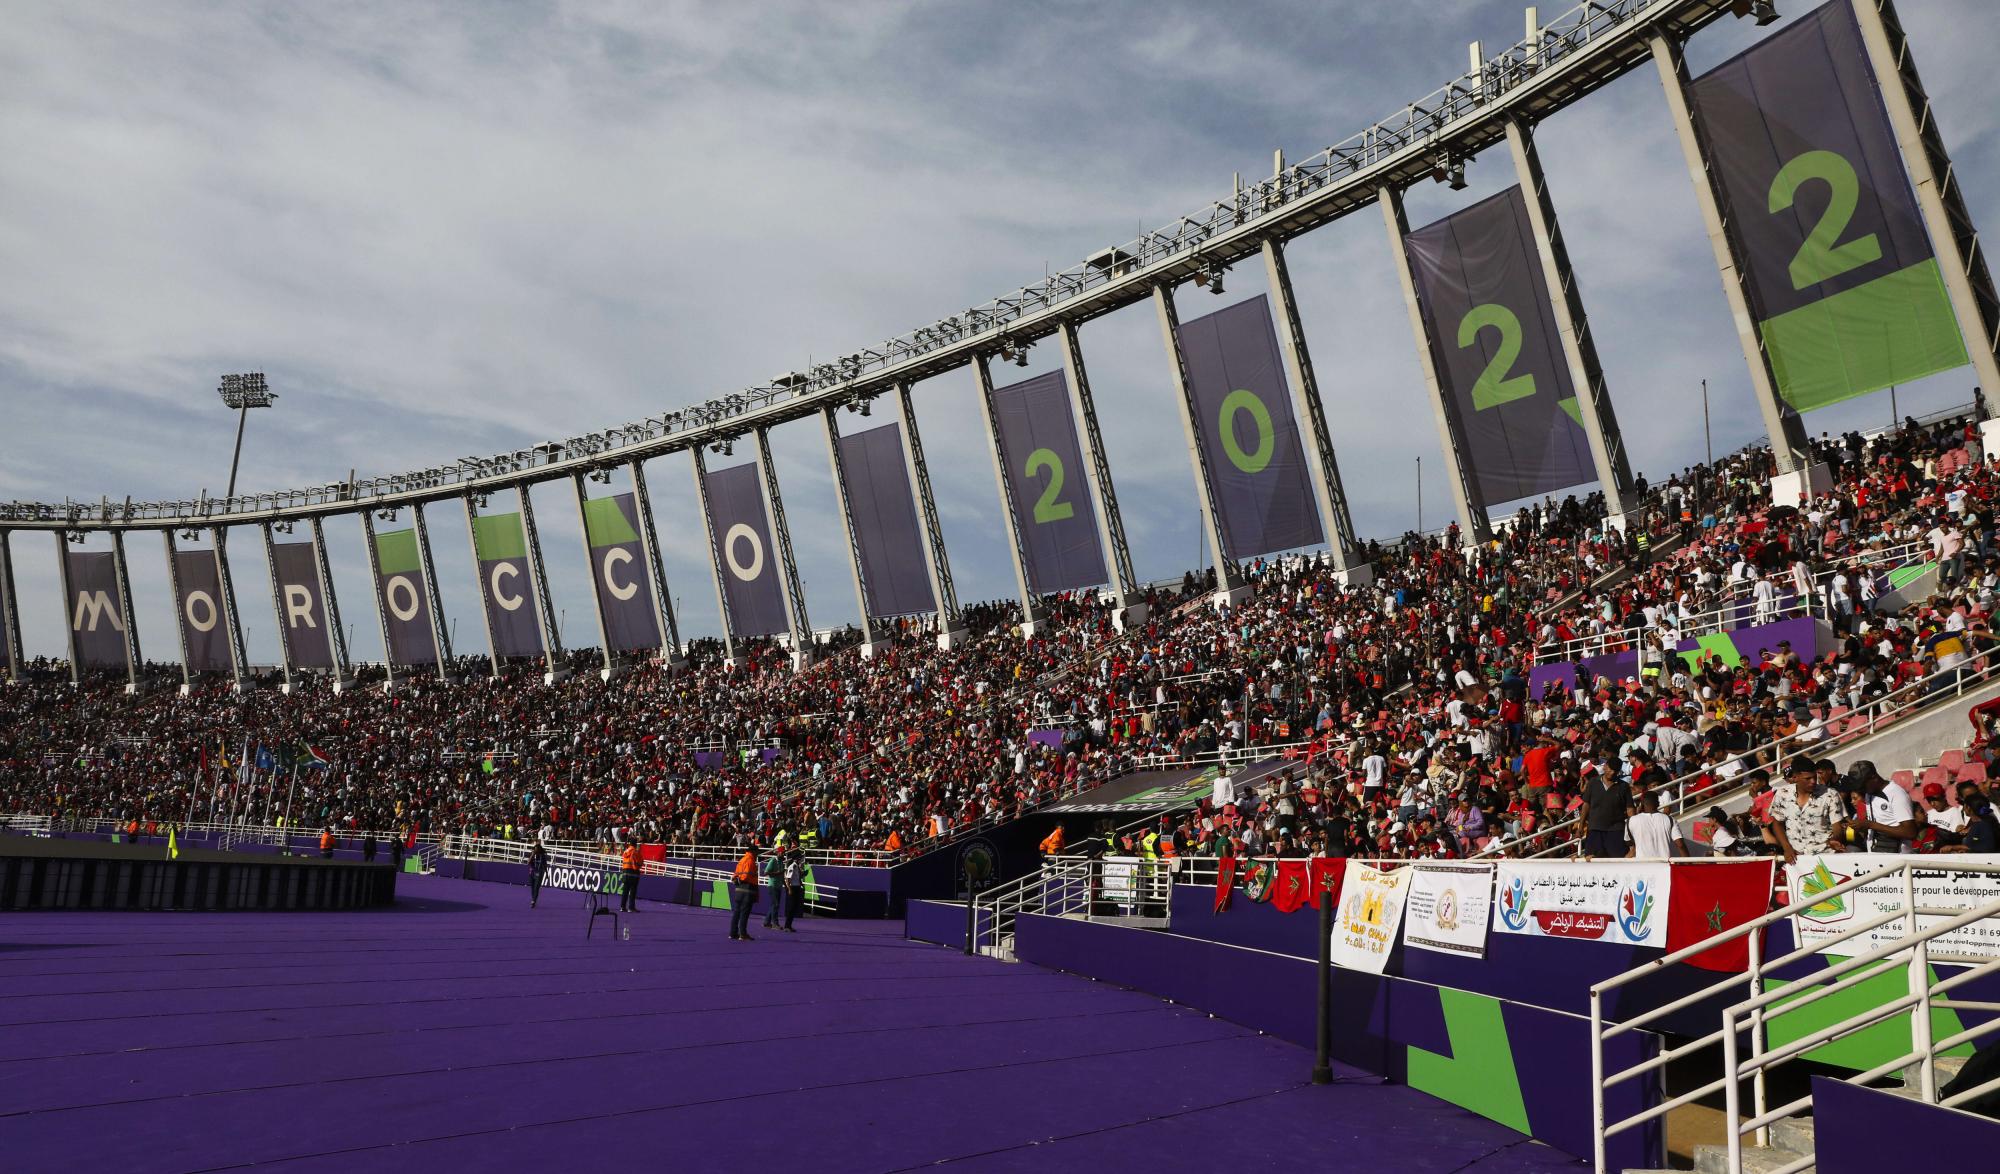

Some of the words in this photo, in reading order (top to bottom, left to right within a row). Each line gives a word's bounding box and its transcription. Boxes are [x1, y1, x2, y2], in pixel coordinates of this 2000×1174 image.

[541, 867, 600, 892] MOROCCO
[603, 873, 624, 895] 202
[1855, 885, 1898, 894] Association
[1922, 887, 1941, 896] pour
[1943, 886, 1951, 895] le
